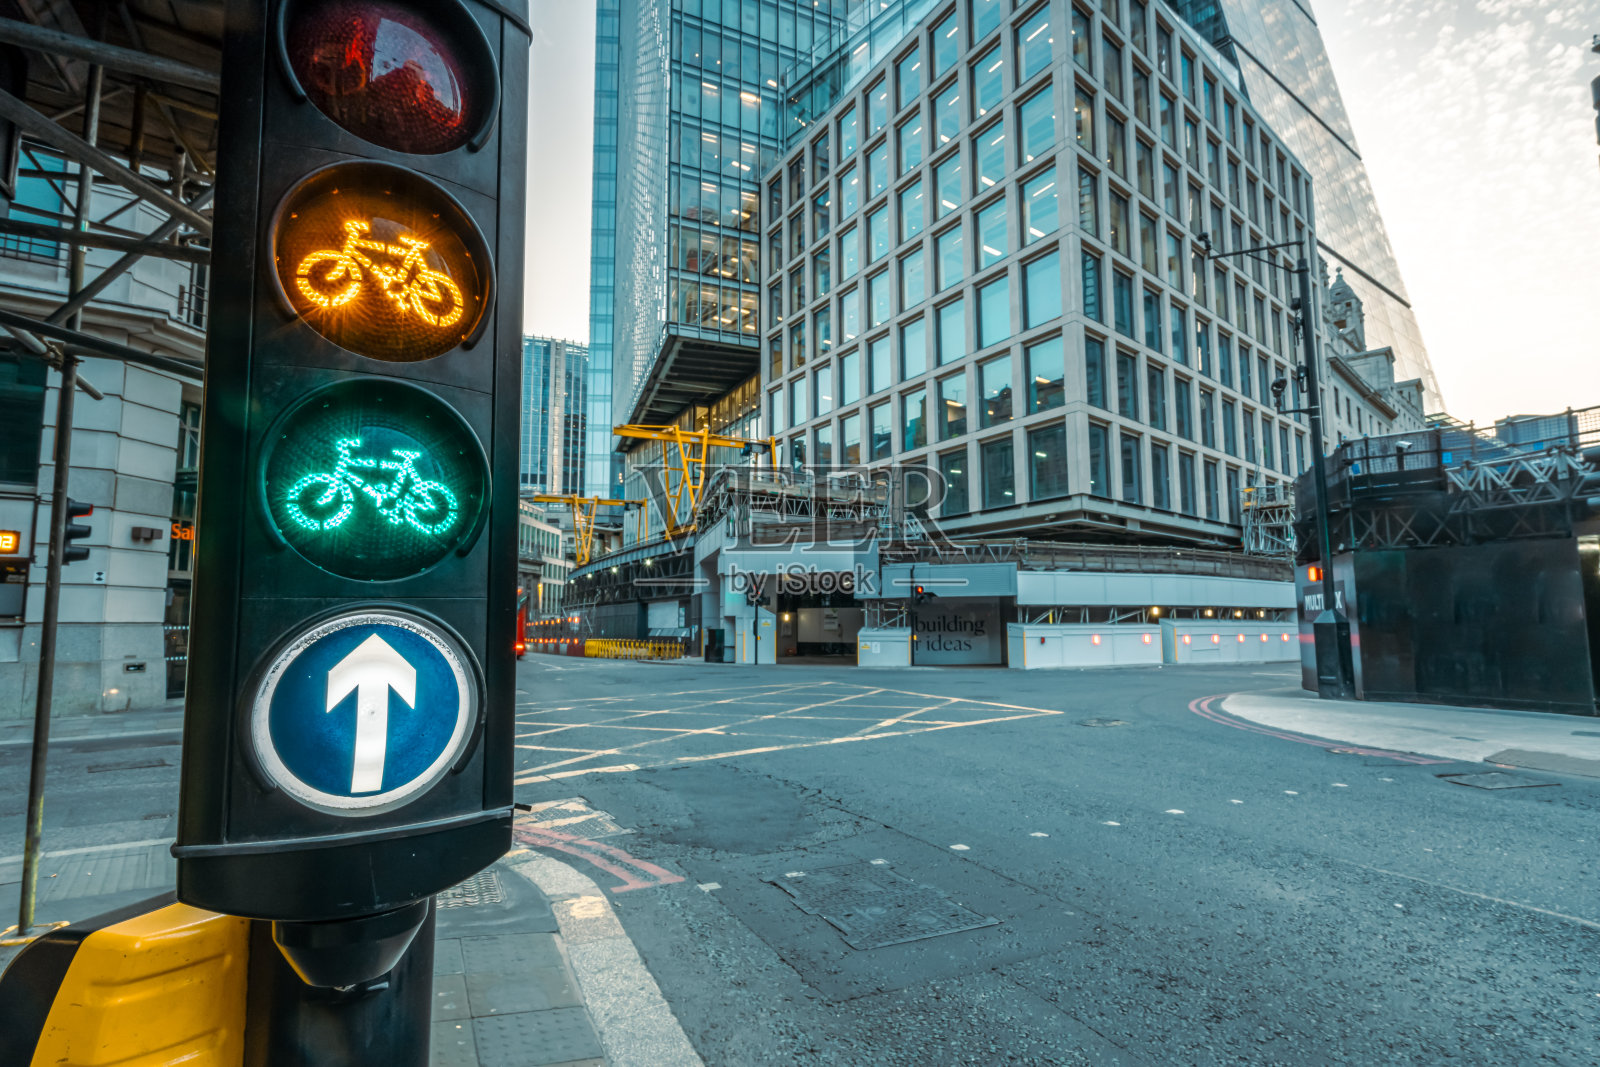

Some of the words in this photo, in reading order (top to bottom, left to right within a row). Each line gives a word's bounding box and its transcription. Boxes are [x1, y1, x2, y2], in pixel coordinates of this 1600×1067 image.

[1304, 591, 1342, 610] MULTIX
[915, 615, 985, 636] building
[926, 634, 972, 651] ideas
